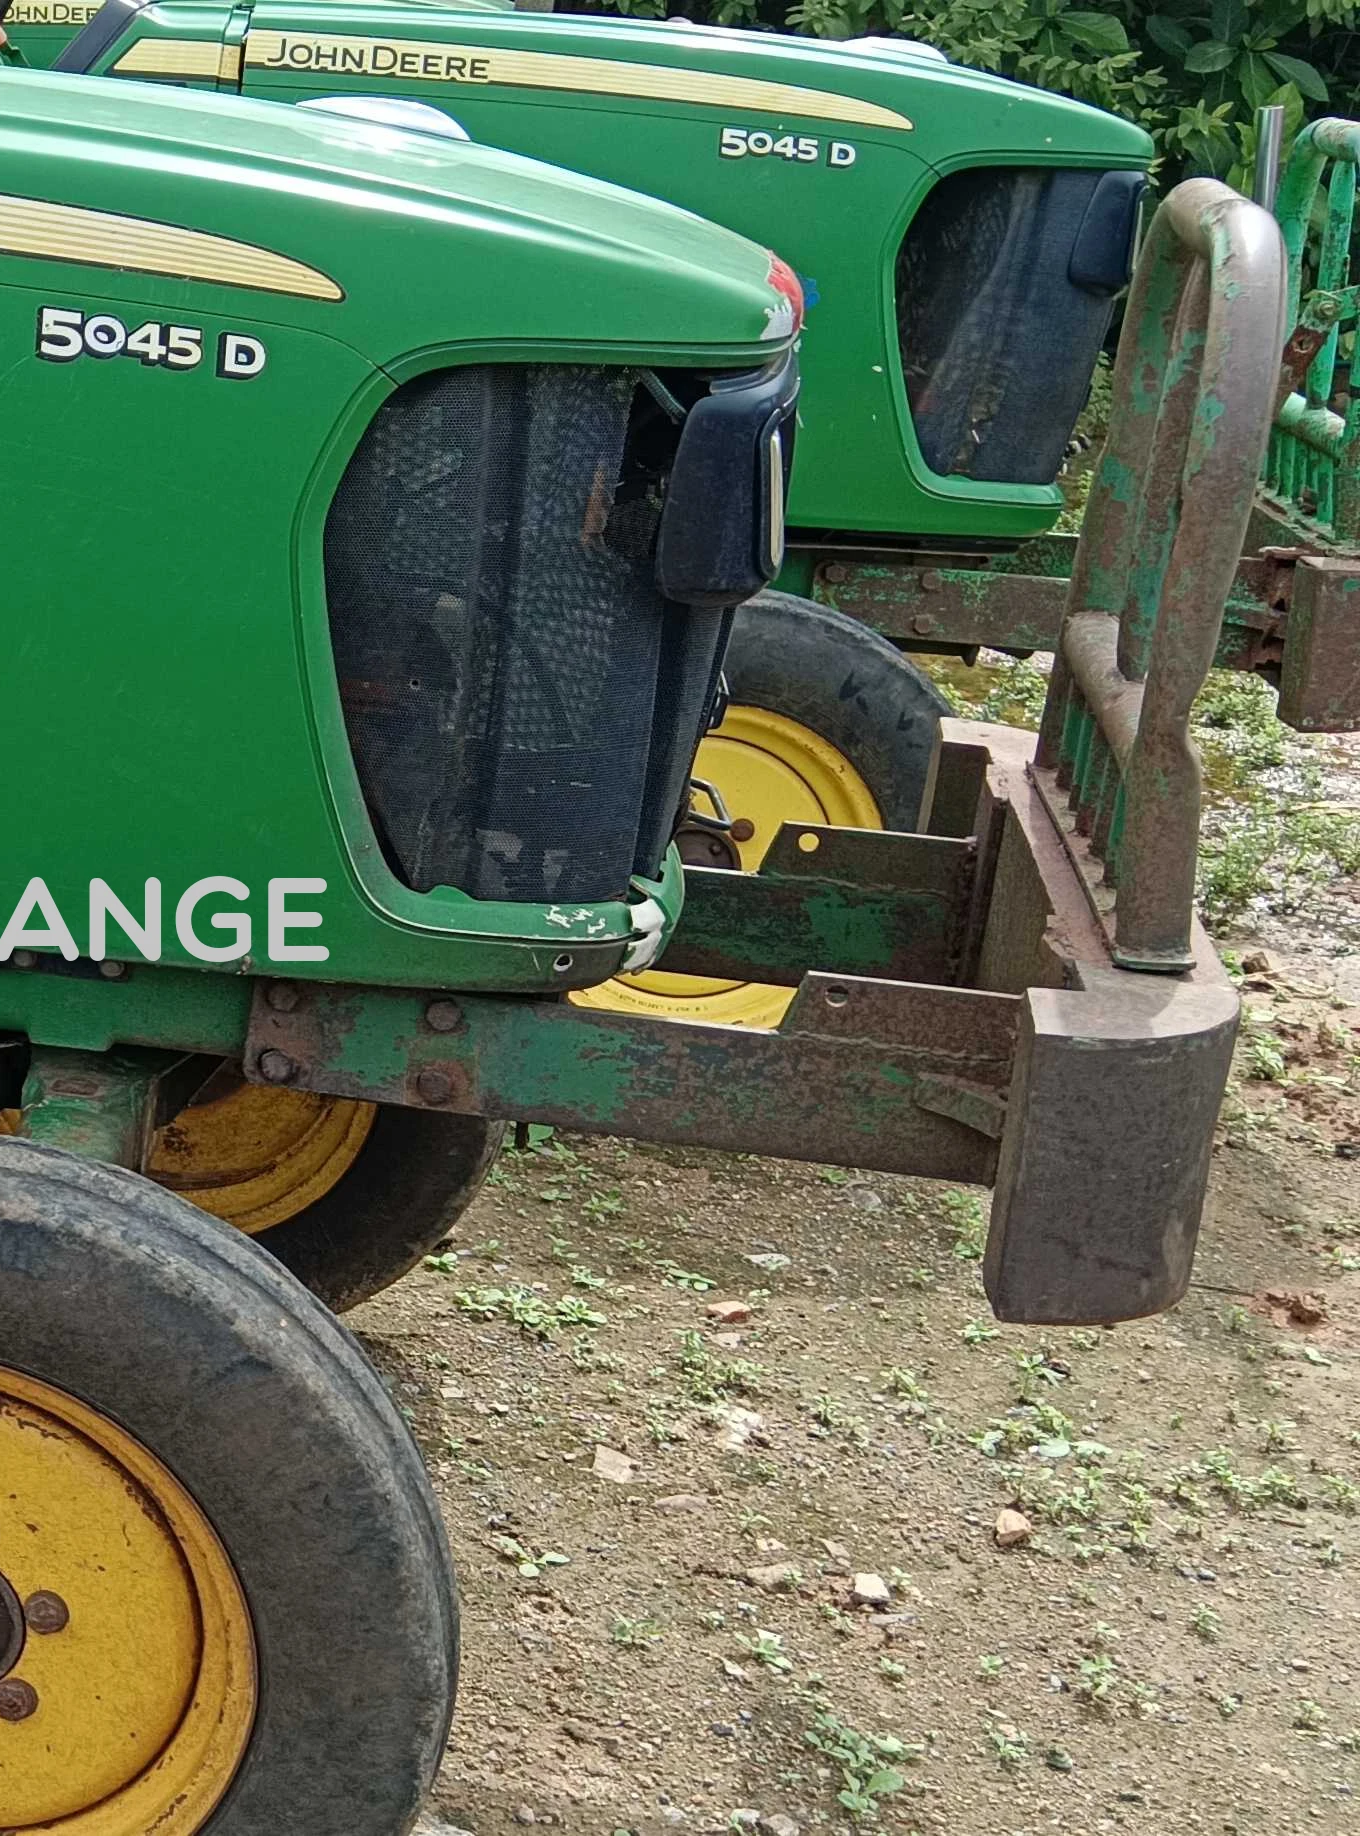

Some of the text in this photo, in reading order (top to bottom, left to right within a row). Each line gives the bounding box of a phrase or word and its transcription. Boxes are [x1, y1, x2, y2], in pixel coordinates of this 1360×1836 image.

[4, 3, 99, 21] OHN DEE
[267, 38, 490, 79] JOHN DEERE
[720, 127, 856, 168] 5045 D
[37, 306, 266, 379] 5045 D
